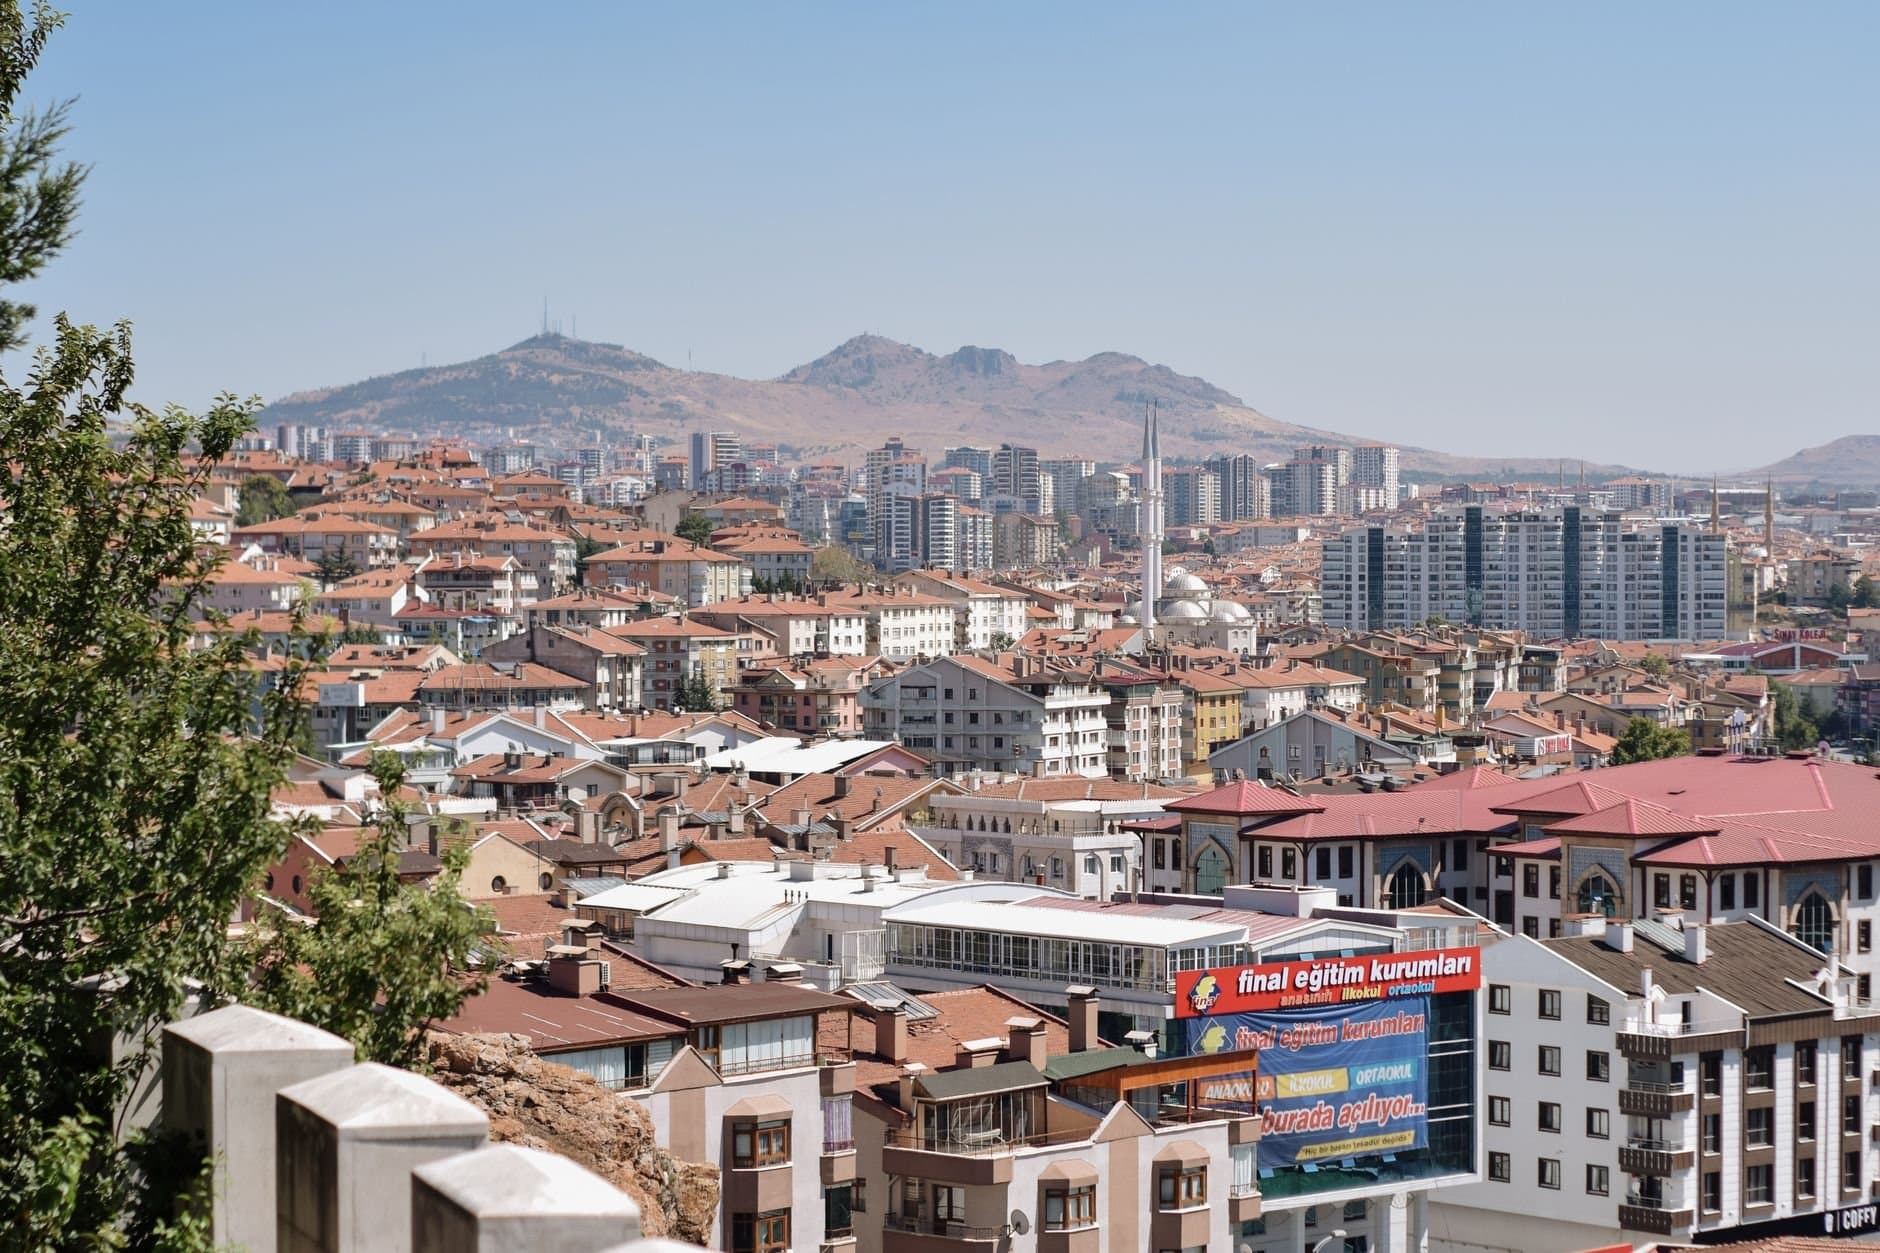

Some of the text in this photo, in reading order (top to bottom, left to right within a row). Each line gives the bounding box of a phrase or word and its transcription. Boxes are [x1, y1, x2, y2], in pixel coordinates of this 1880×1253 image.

[1239, 953, 1472, 993] final eğitim kurumları
[1388, 980, 1435, 996] ortaokul
[1235, 1010, 1425, 1052] final eğitim kurumları
[1356, 1063, 1412, 1086] ORTAOKUL
[1261, 1100, 1334, 1136] burada
[1843, 1206, 1877, 1230] COFFY
